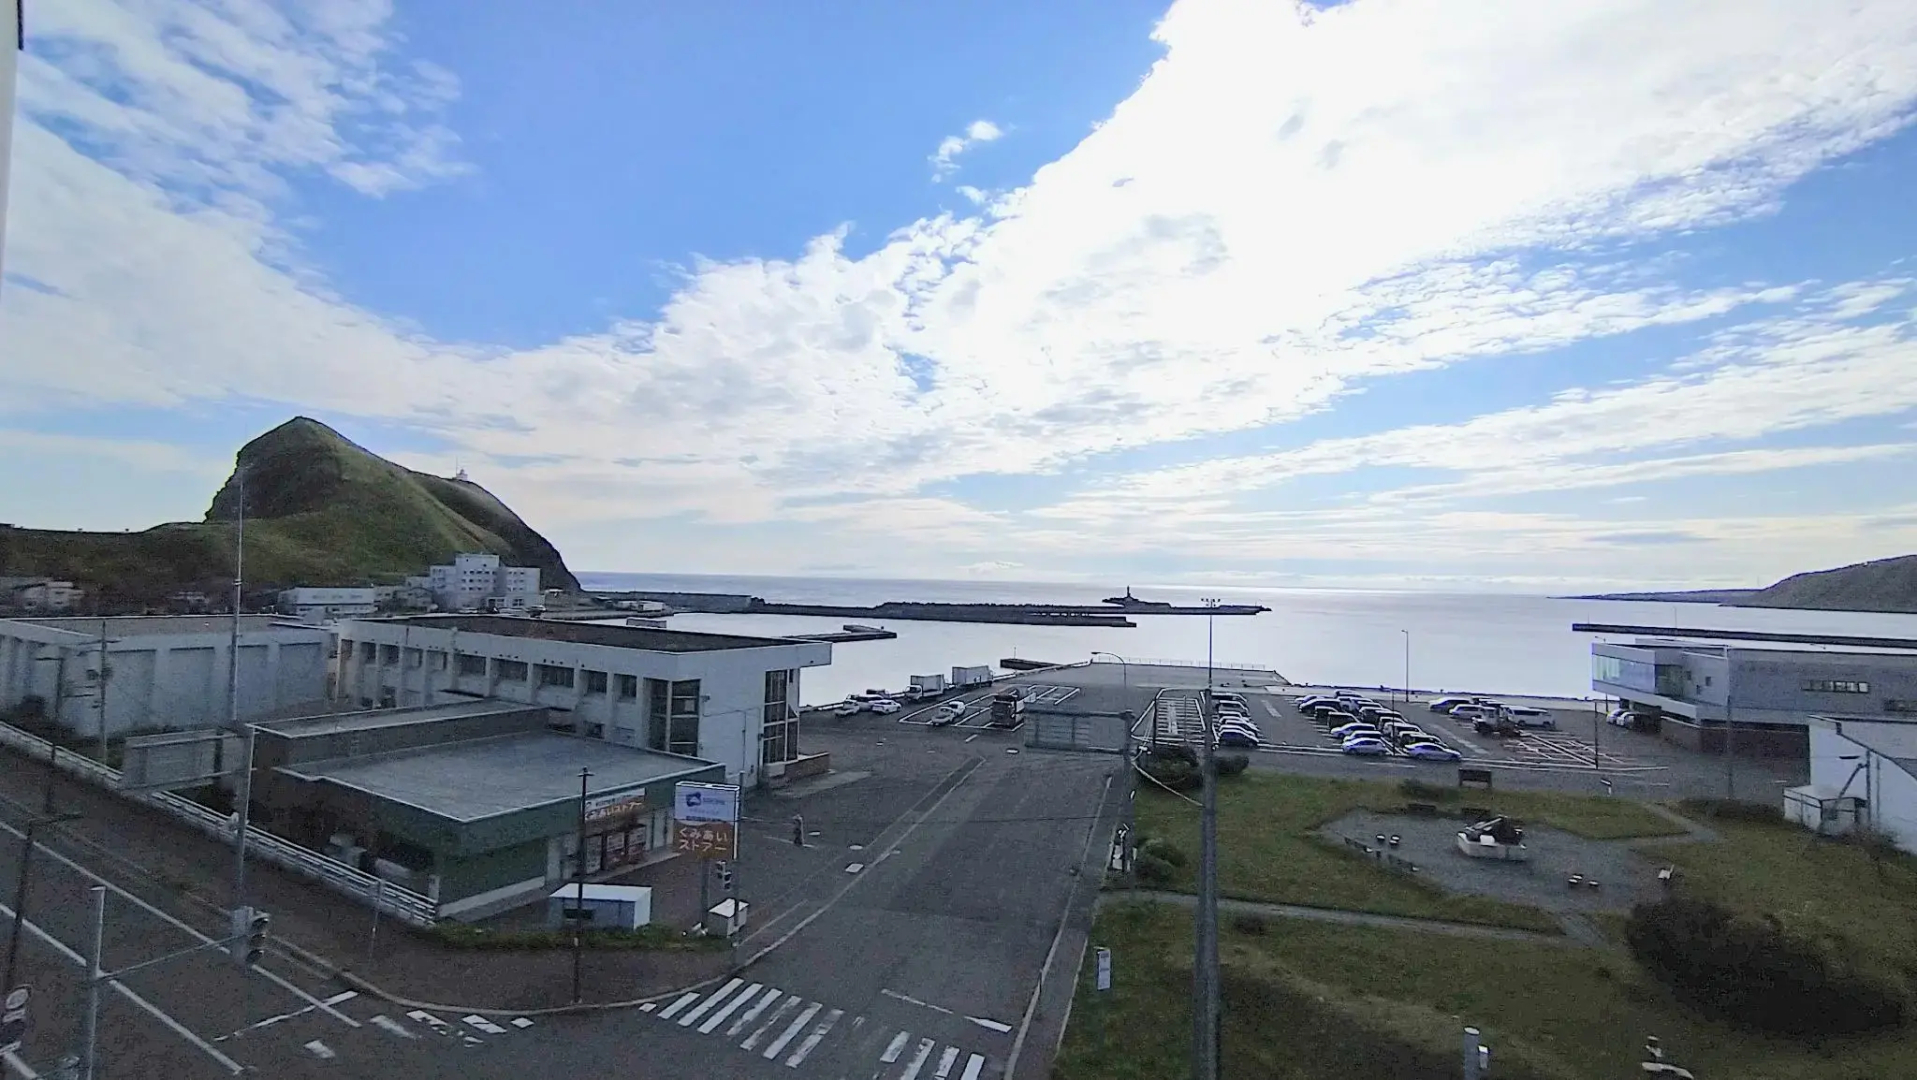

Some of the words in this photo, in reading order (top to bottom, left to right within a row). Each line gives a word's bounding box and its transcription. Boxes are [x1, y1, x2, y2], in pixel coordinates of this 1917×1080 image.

[679, 827, 728, 842] くみあい
[679, 839, 727, 852] ストアー
